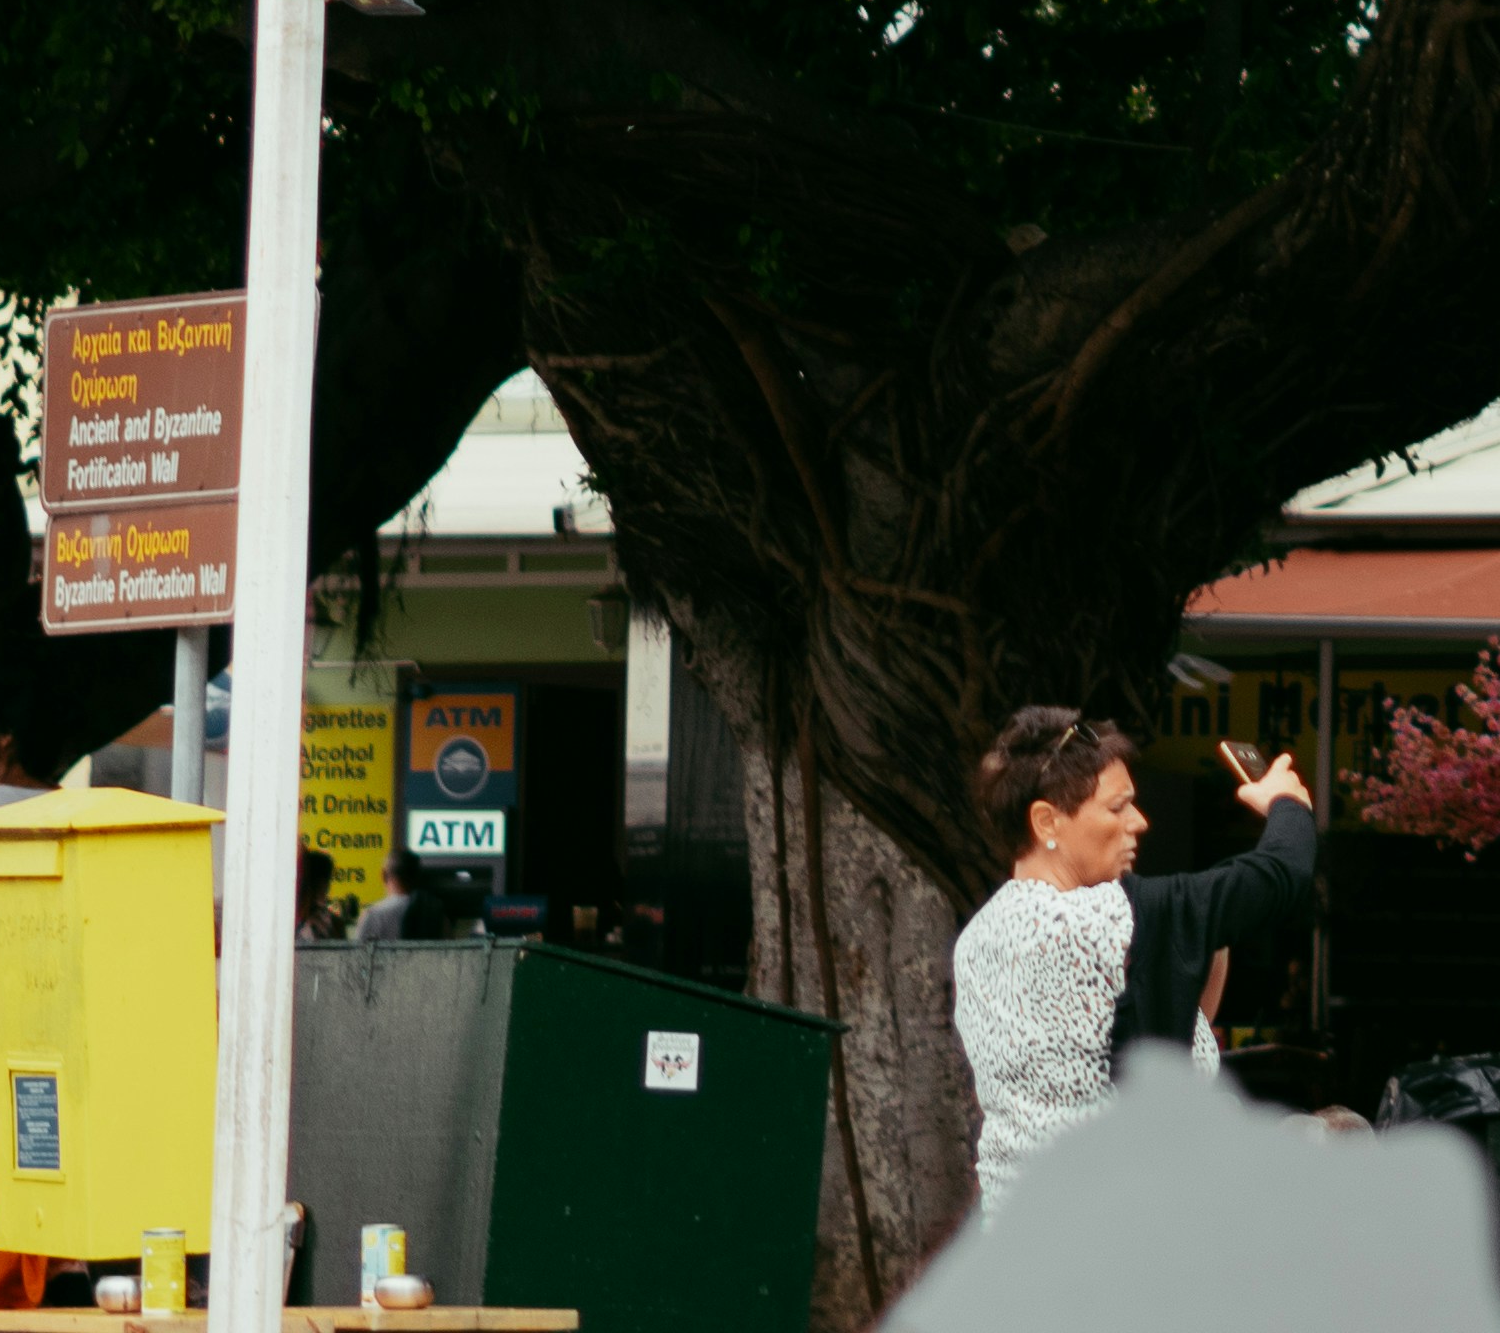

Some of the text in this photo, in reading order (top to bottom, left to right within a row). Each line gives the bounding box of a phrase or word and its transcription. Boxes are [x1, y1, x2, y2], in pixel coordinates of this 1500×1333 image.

[72, 310, 232, 365] Αρχαία και Βυζαντινή
[71, 368, 138, 409] Οχύρωση
[69, 403, 222, 447] Ancient and Byzantine
[67, 450, 179, 491] Fortification Wall
[56, 521, 190, 568] Βυζαντινή Οχύρωση
[55, 562, 228, 613] Byzantine Fortification Wall
[303, 708, 387, 734] garettes
[425, 707, 501, 727] ATM
[1160, 683, 1230, 735] ini
[300, 743, 374, 762] Alcohol
[301, 761, 366, 780] Drinks
[303, 794, 388, 814] ft Drinks
[316, 827, 383, 849] Cream
[418, 820, 495, 847] ATM
